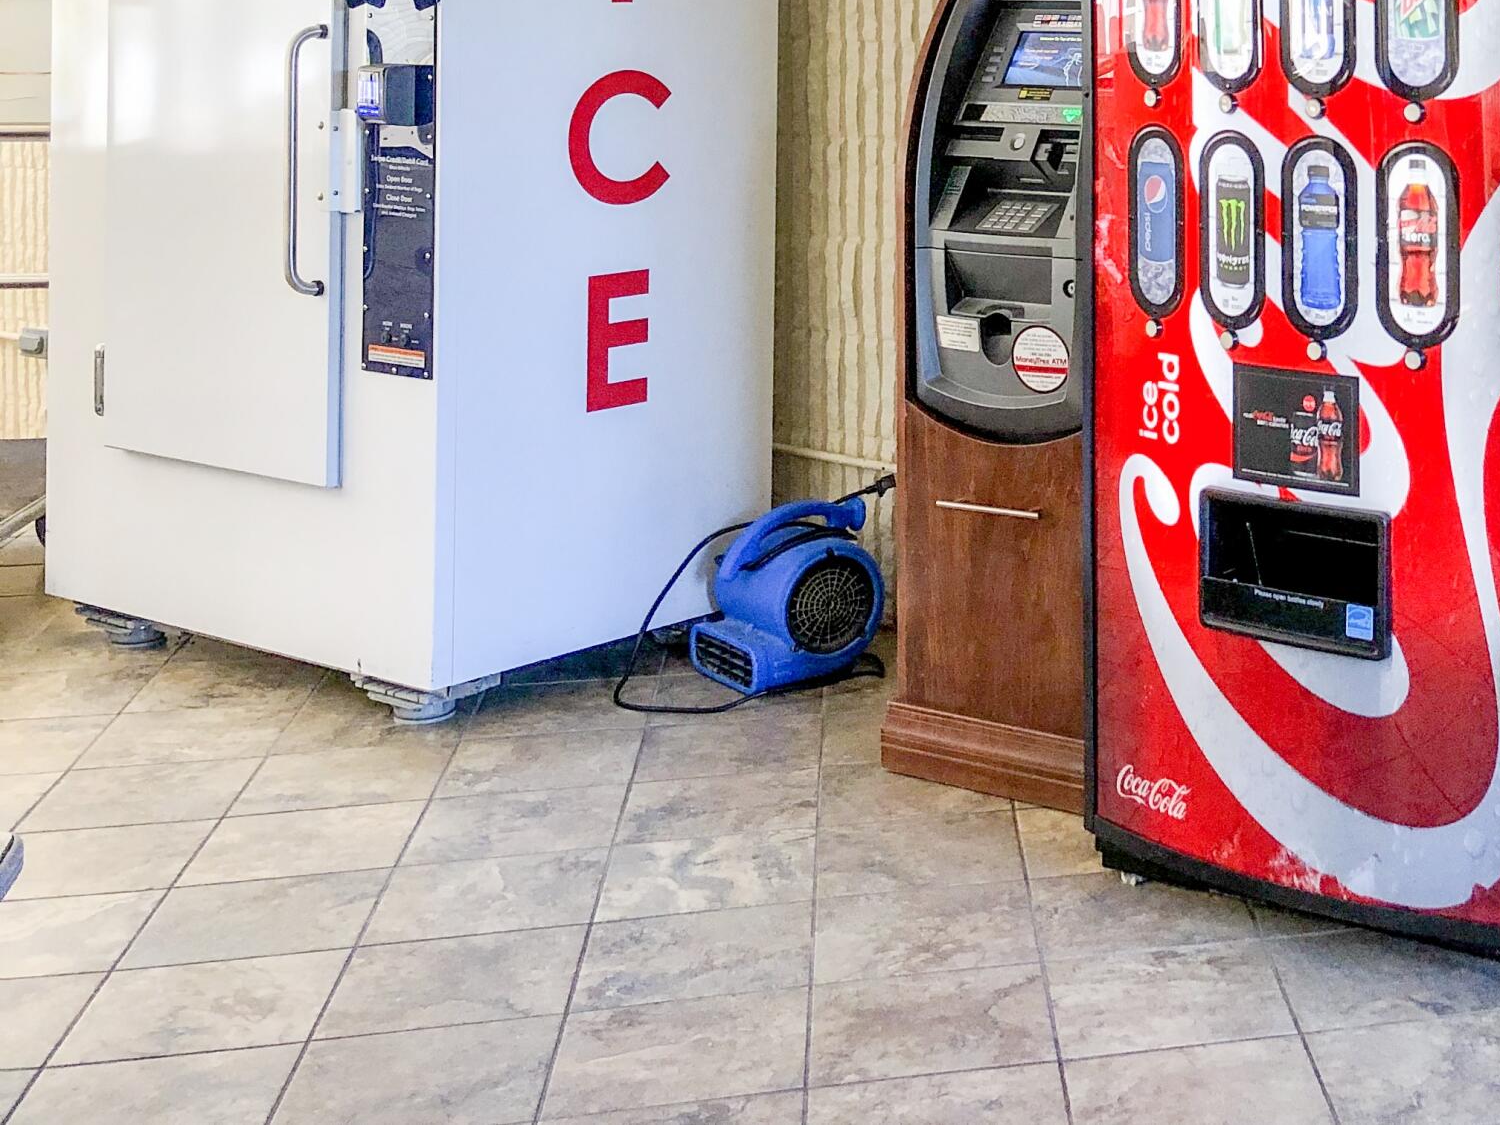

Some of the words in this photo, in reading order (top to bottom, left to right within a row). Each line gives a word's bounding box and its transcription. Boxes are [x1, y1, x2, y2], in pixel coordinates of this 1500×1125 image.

[1139, 380, 1159, 440] ice
[1158, 352, 1180, 444] cold
[1116, 764, 1191, 820] Coca-Cola
